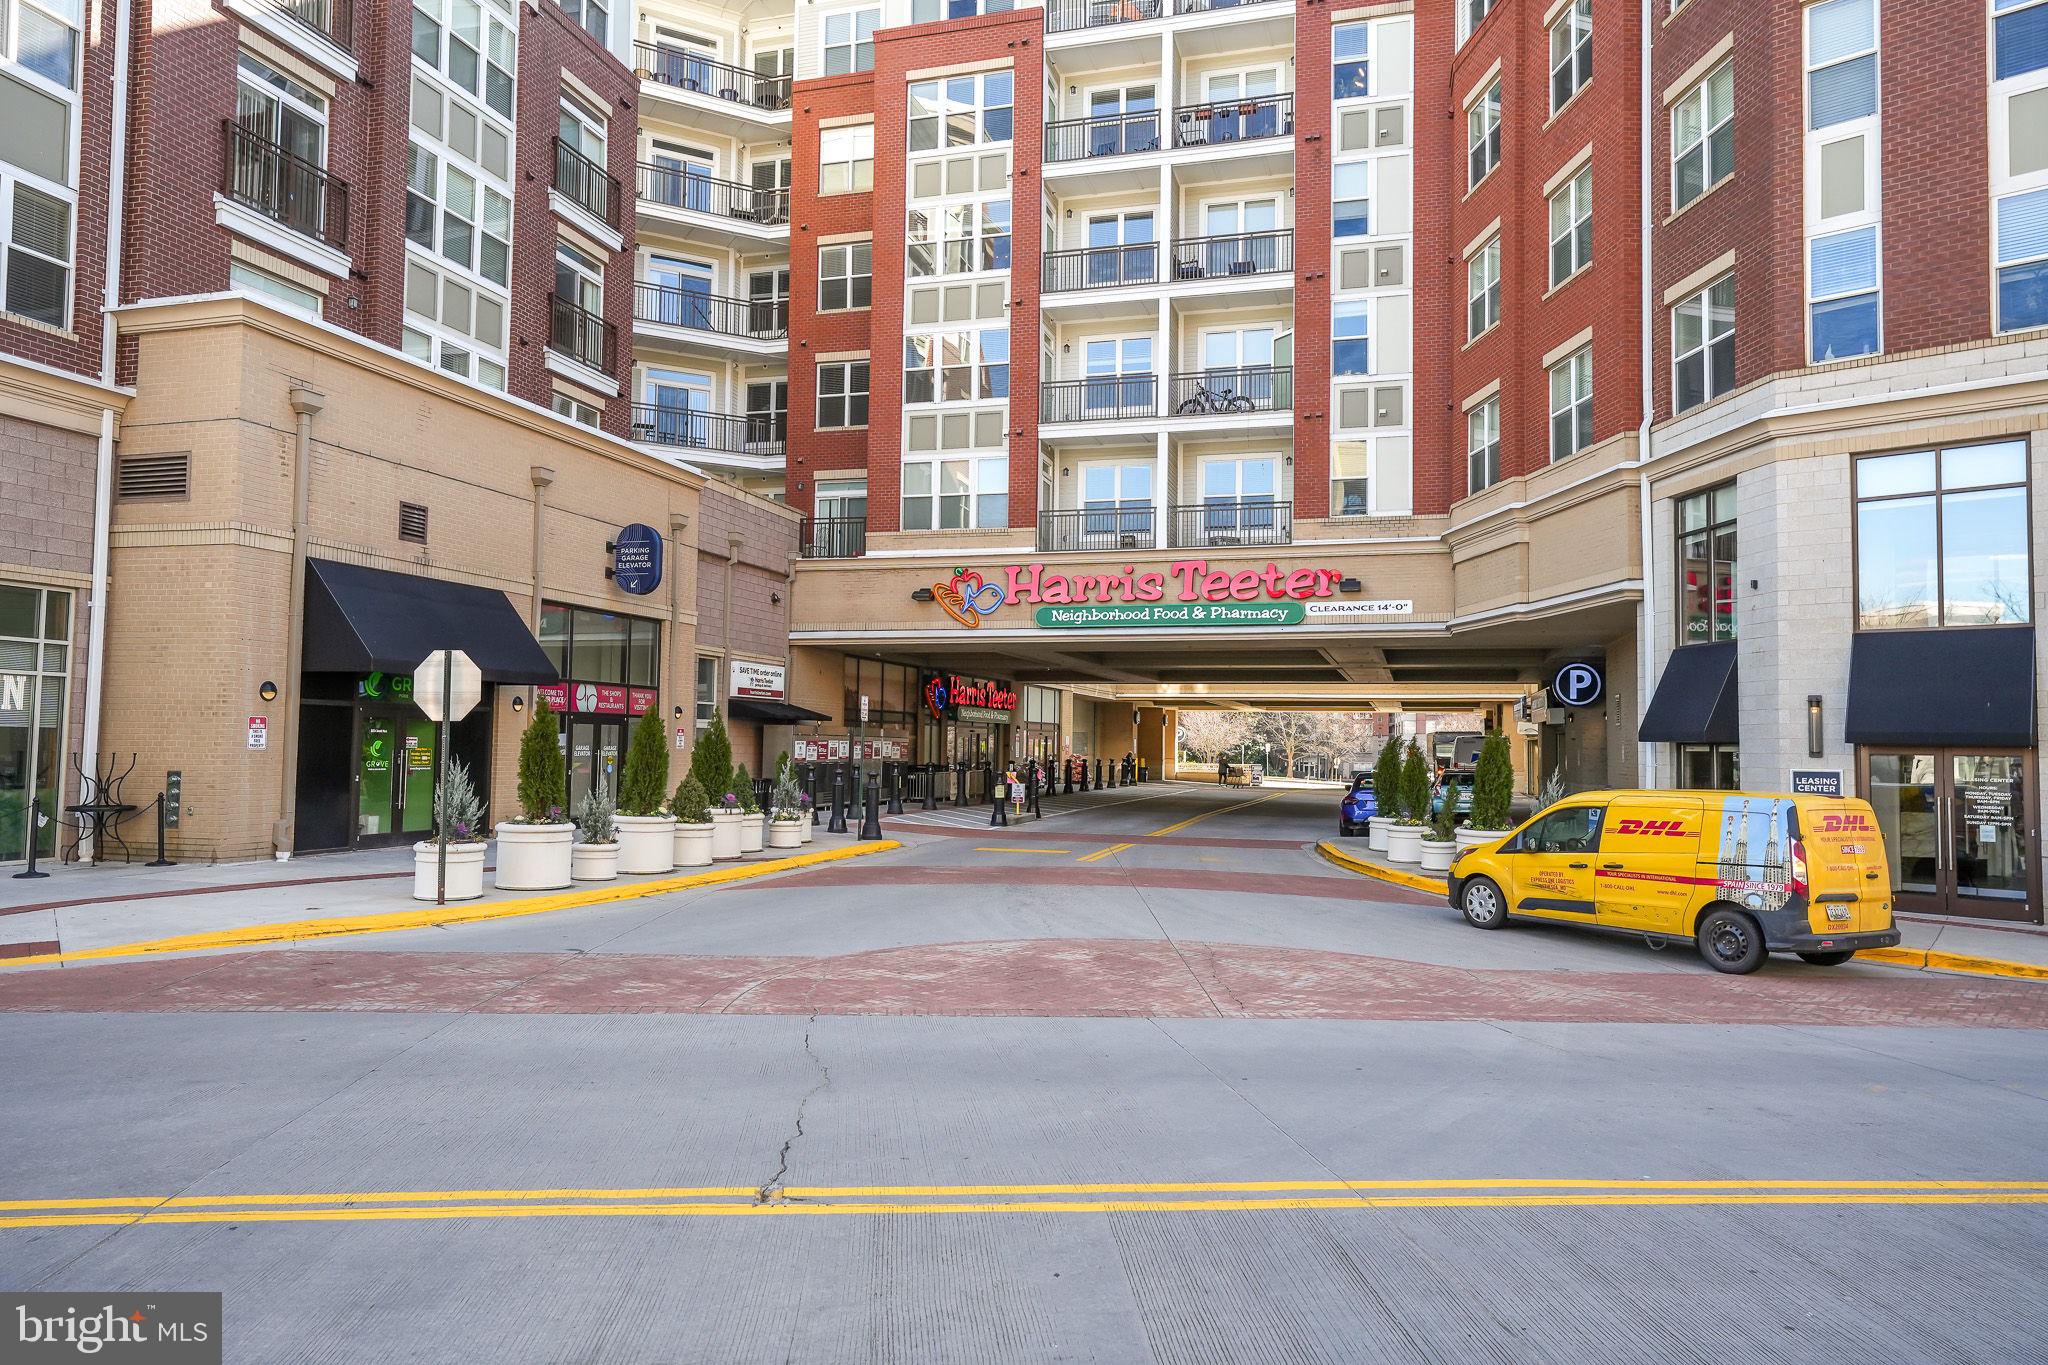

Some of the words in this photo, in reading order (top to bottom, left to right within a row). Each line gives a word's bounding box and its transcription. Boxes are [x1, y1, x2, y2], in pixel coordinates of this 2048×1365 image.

[1004, 564, 1164, 605] Harris
[1171, 560, 1342, 600] Teeter
[1051, 607, 1150, 624] Neighborhood
[1153, 607, 1189, 620] Food
[1192, 606, 1205, 618] &
[1210, 606, 1288, 622] Pharmacy
[1310, 604, 1375, 613] CLEARANCE
[739, 666, 749, 674] SAVE
[950, 675, 986, 706] Harris
[987, 681, 1017, 710] Teeter
[1569, 670, 1592, 700] P
[1796, 777, 1837, 785] LEASING
[1617, 819, 1687, 837] DHL
[1823, 816, 1870, 832] DHL
[1646, 874, 1677, 882] INTERNATIONAL
[1723, 881, 1744, 889] SPAIN
